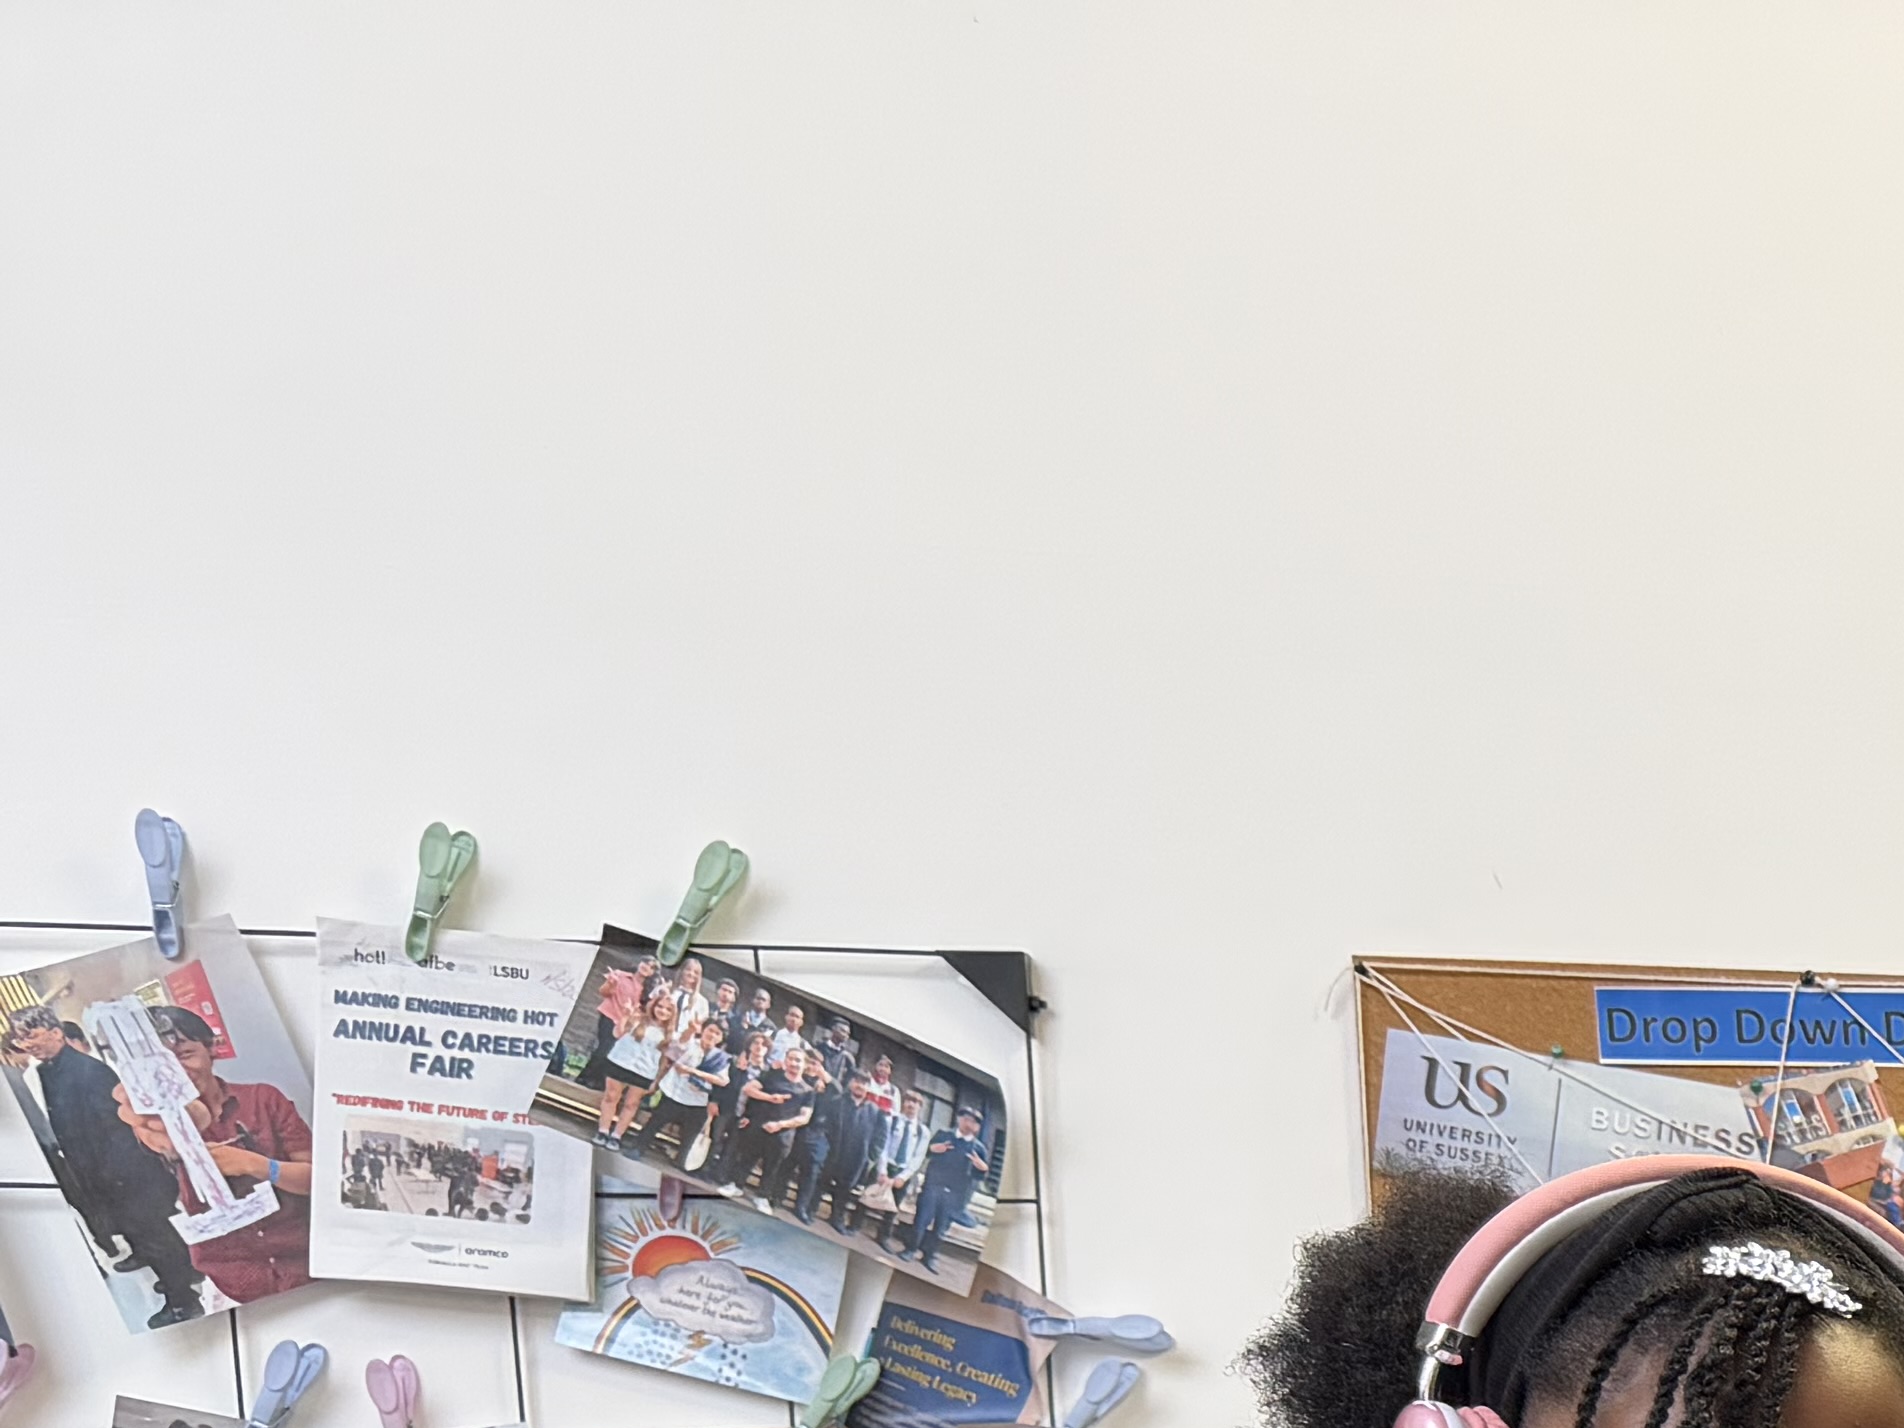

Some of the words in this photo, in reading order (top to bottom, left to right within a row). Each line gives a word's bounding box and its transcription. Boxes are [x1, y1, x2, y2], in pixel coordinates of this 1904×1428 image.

[353, 948, 386, 965] hot!
[493, 966, 530, 980] LSBU
[334, 989, 399, 1010] MAKING
[405, 996, 518, 1024] ENGINEERING
[523, 1009, 559, 1028] HOT
[333, 1018, 432, 1047] ANNUAL
[441, 1029, 555, 1060] CAREERS
[1606, 1006, 1718, 1053] Drop
[1736, 1008, 1868, 1048] Down
[409, 1052, 475, 1080] FAIR
[1420, 1053, 1511, 1120] US
[407, 1100, 435, 1114] THE
[437, 1103, 488, 1120] FUTURE
[491, 1111, 508, 1121] OF
[1403, 1118, 1517, 1149] UNIVERSITY
[1405, 1138, 1428, 1153] OF
[1590, 1107, 1756, 1156] BUSINESS
[465, 1248, 509, 1258] aramco
[890, 1315, 956, 1351] Delivering
[884, 1335, 953, 1372] Excellence,
[955, 1361, 1020, 1398] Creating
[884, 1357, 932, 1388] Lasting
[933, 1375, 977, 1404] Legacy
